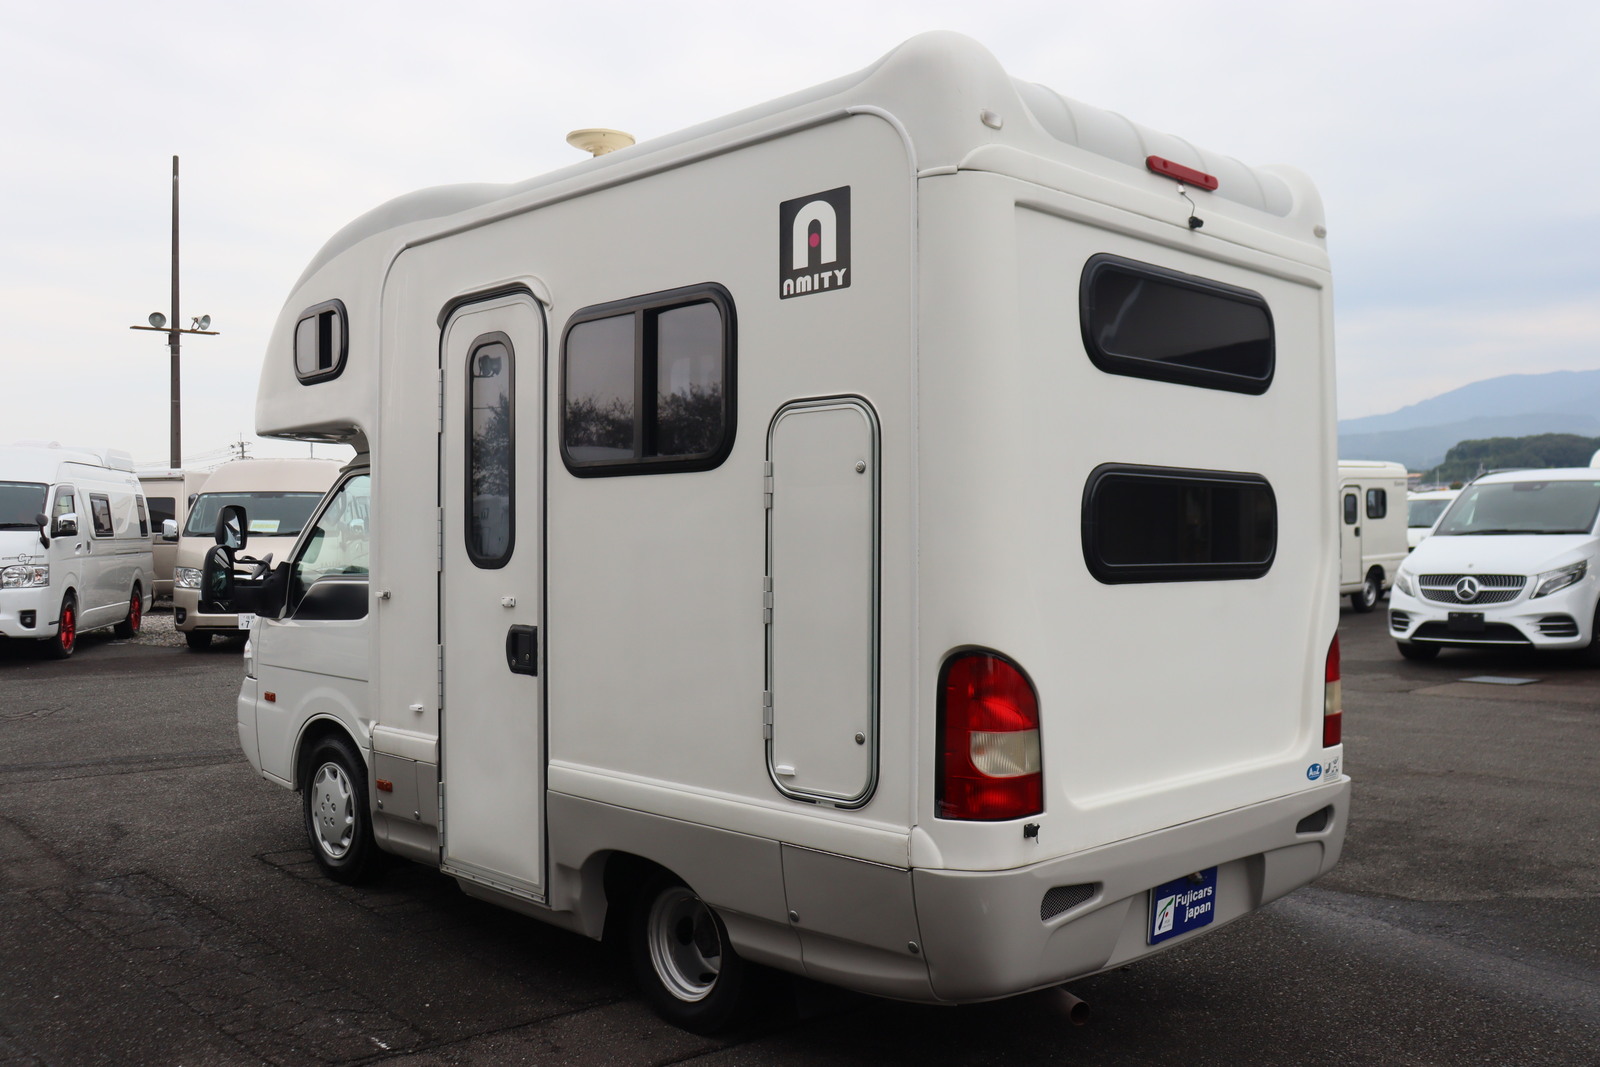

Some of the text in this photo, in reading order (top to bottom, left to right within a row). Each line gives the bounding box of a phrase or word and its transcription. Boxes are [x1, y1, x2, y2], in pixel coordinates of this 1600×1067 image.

[783, 268, 847, 296] AMITY
[1176, 886, 1212, 907] Fujicars
[1184, 902, 1211, 922] japan
